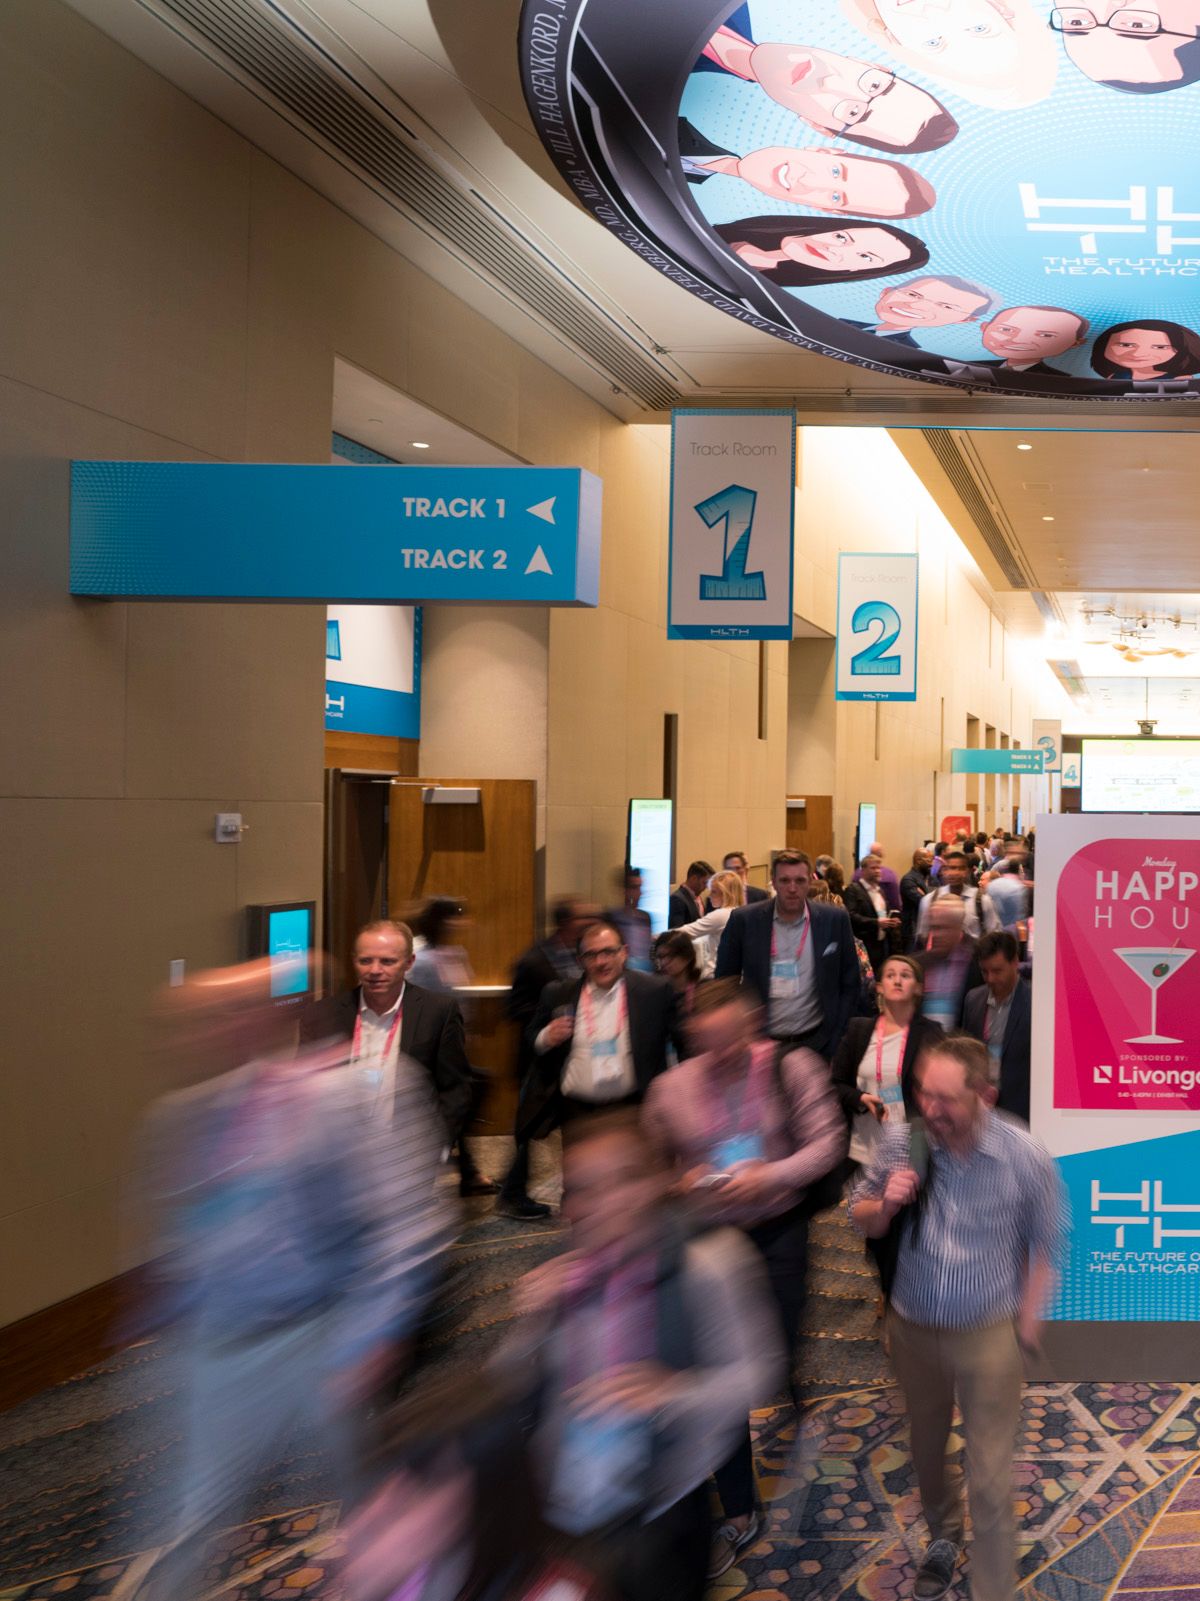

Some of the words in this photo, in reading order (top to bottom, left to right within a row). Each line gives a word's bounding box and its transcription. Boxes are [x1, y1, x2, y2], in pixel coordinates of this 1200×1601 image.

[530, 13, 567, 124] HAGENKORD,
[547, 126, 577, 158] JILL
[1042, 256, 1101, 266] THE
[713, 299, 767, 328] DAVID
[689, 442, 730, 456] Track
[733, 442, 777, 456] Room
[403, 497, 486, 518] TRACK
[495, 498, 506, 518] 1
[694, 483, 768, 601] 1
[401, 548, 485, 569] TRACK
[492, 549, 508, 570] 2
[710, 628, 750, 636] HLTH
[851, 600, 901, 675] 2
[1037, 736, 1057, 763] 3
[1063, 764, 1078, 782] 4
[1142, 856, 1177, 874] Monday
[1120, 1054, 1171, 1062] SPONSORED
[1174, 1054, 1188, 1062] BY:
[1091, 1251, 1121, 1261] THE
[1125, 1252, 1187, 1261] FUTURE
